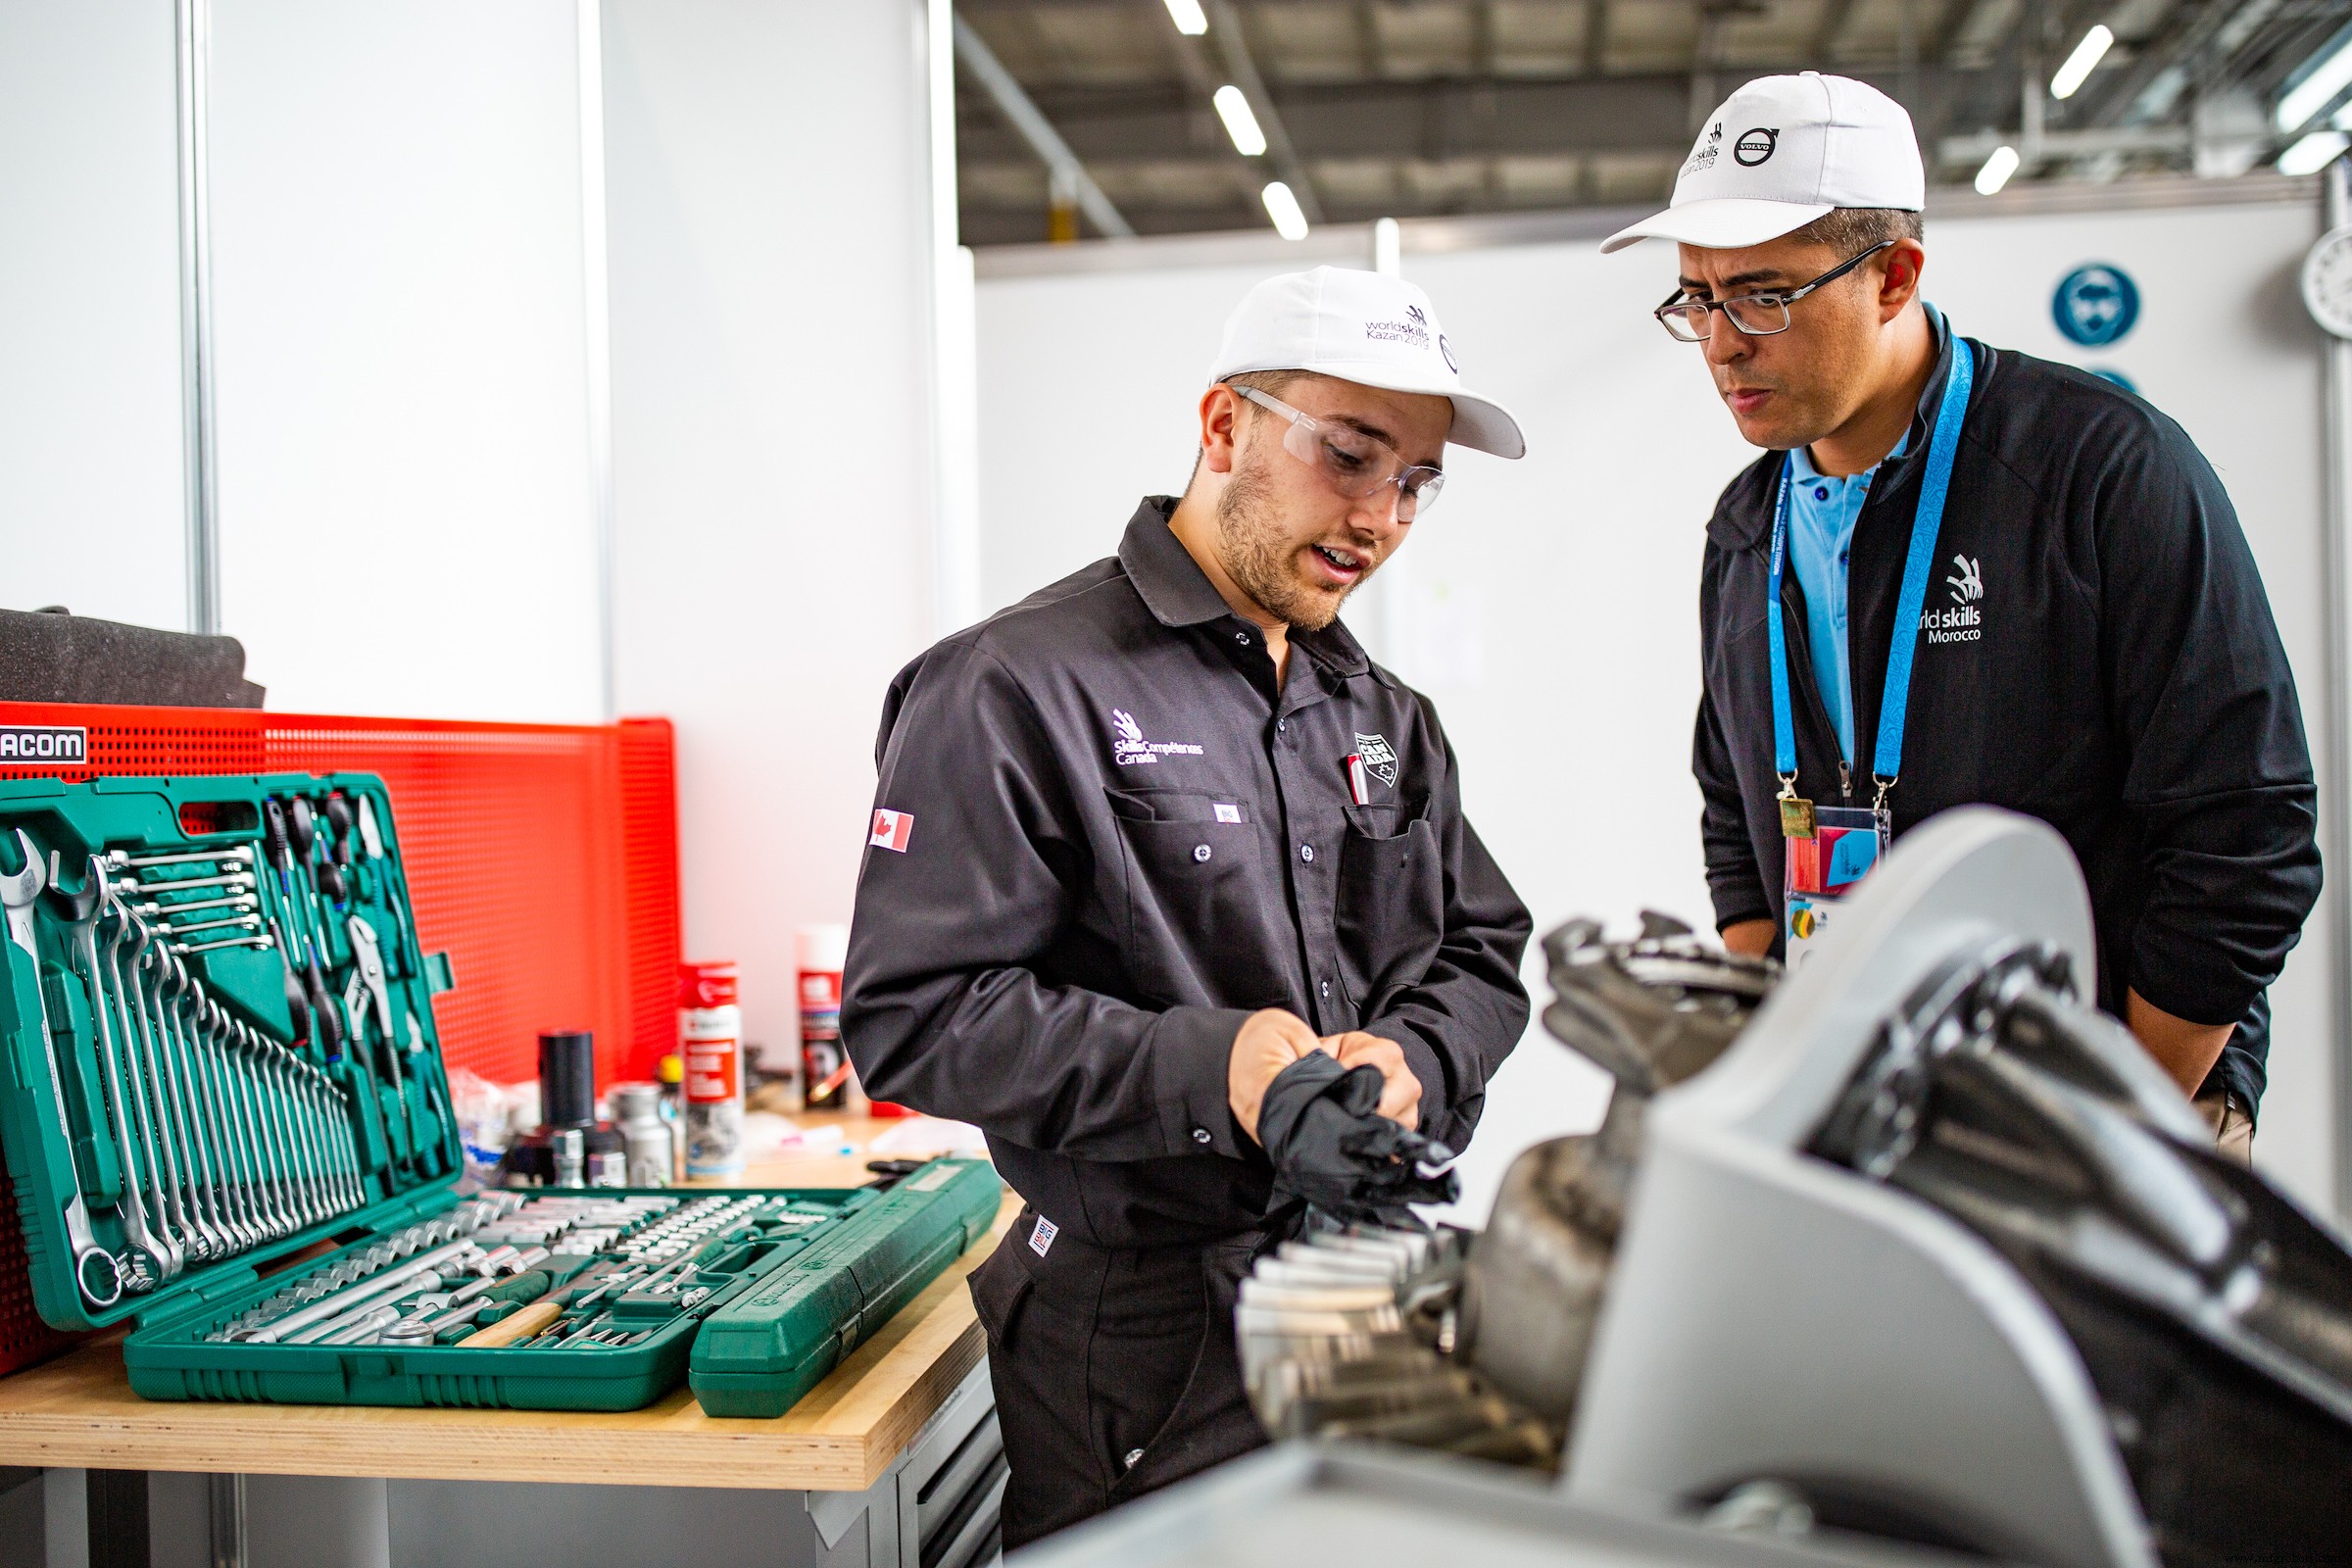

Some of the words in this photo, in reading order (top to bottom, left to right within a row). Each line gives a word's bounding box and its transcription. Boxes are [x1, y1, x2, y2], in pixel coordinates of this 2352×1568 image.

[1365, 320, 1429, 341] worldskills
[1366, 329, 1403, 342] Kazan
[1404, 334, 1429, 351] 2019
[1918, 609, 1940, 630] rld
[1929, 629, 1982, 644] Morocco
[0, 733, 82, 757] ACOM
[1115, 753, 1157, 764] Canada
[1038, 1223, 1054, 1240] BIG
